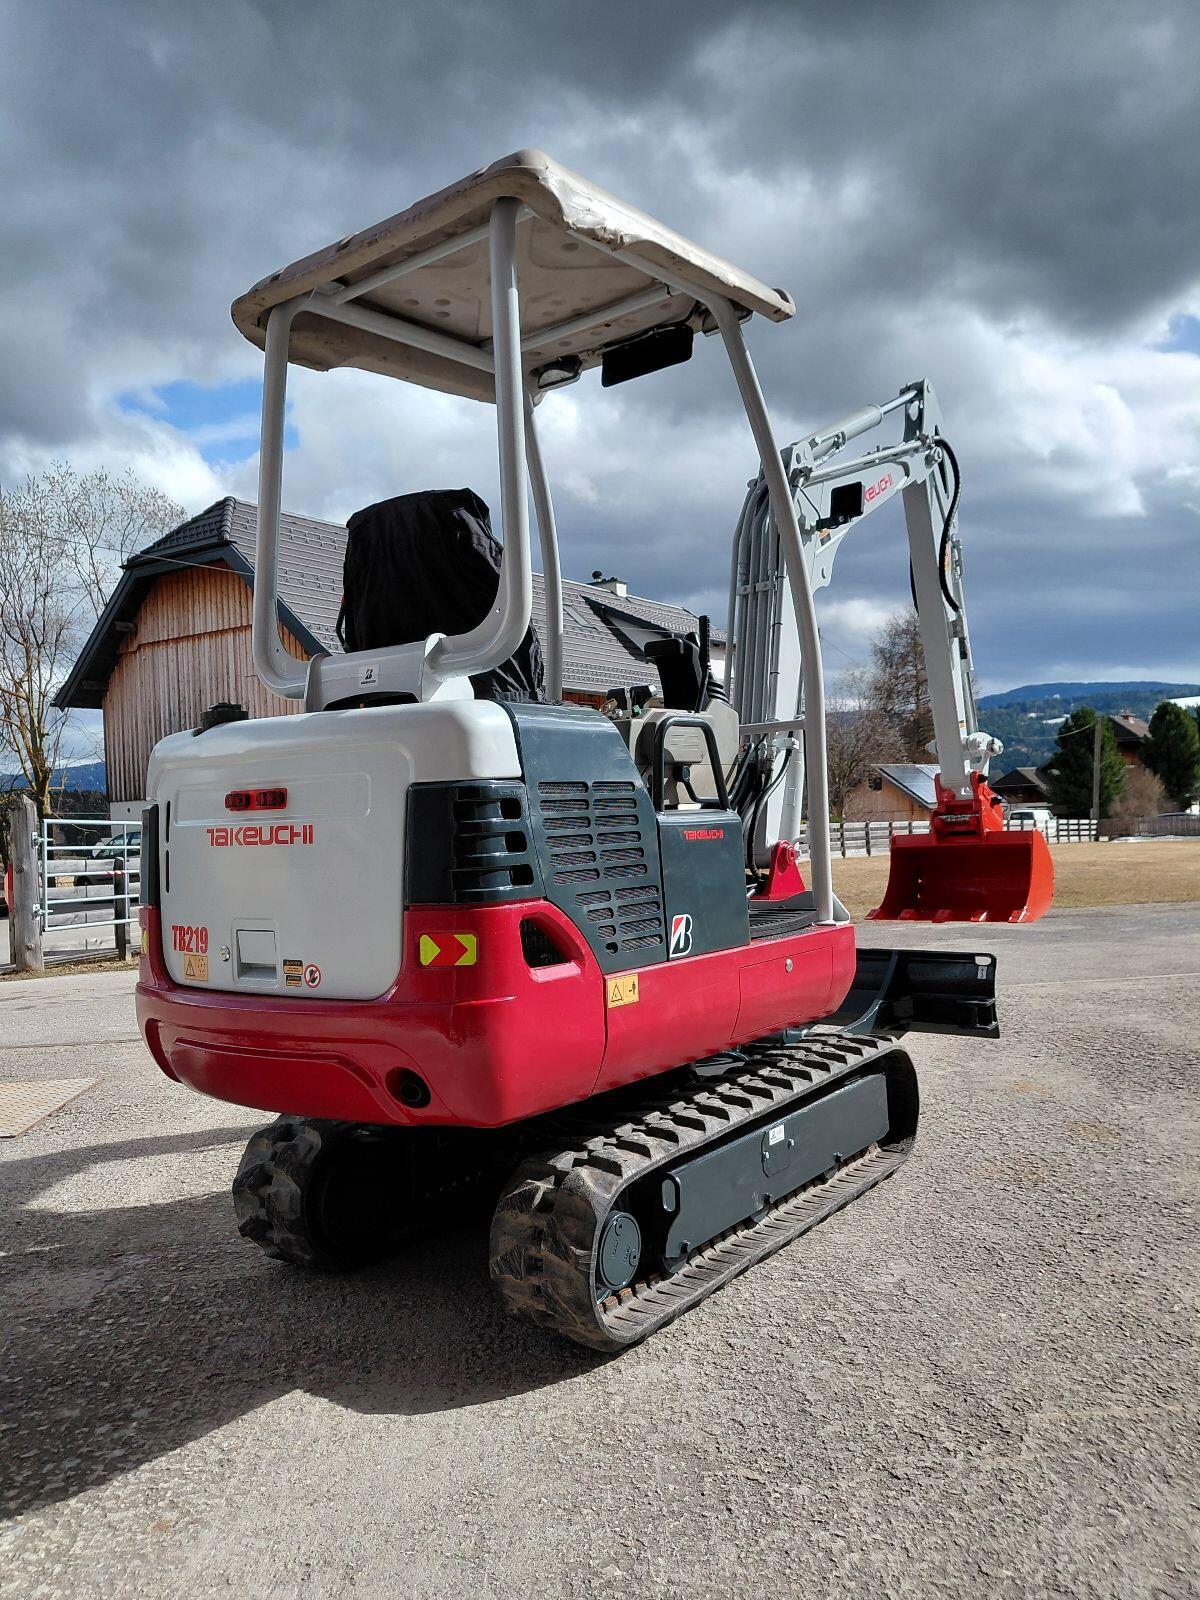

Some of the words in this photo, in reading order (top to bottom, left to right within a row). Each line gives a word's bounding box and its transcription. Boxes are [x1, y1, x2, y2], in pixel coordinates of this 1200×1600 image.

[863, 473, 894, 503] KEUCHI
[206, 824, 314, 847] TAKEUCHI
[684, 829, 723, 840] TAKEUCHI
[171, 924, 209, 955] TB219
